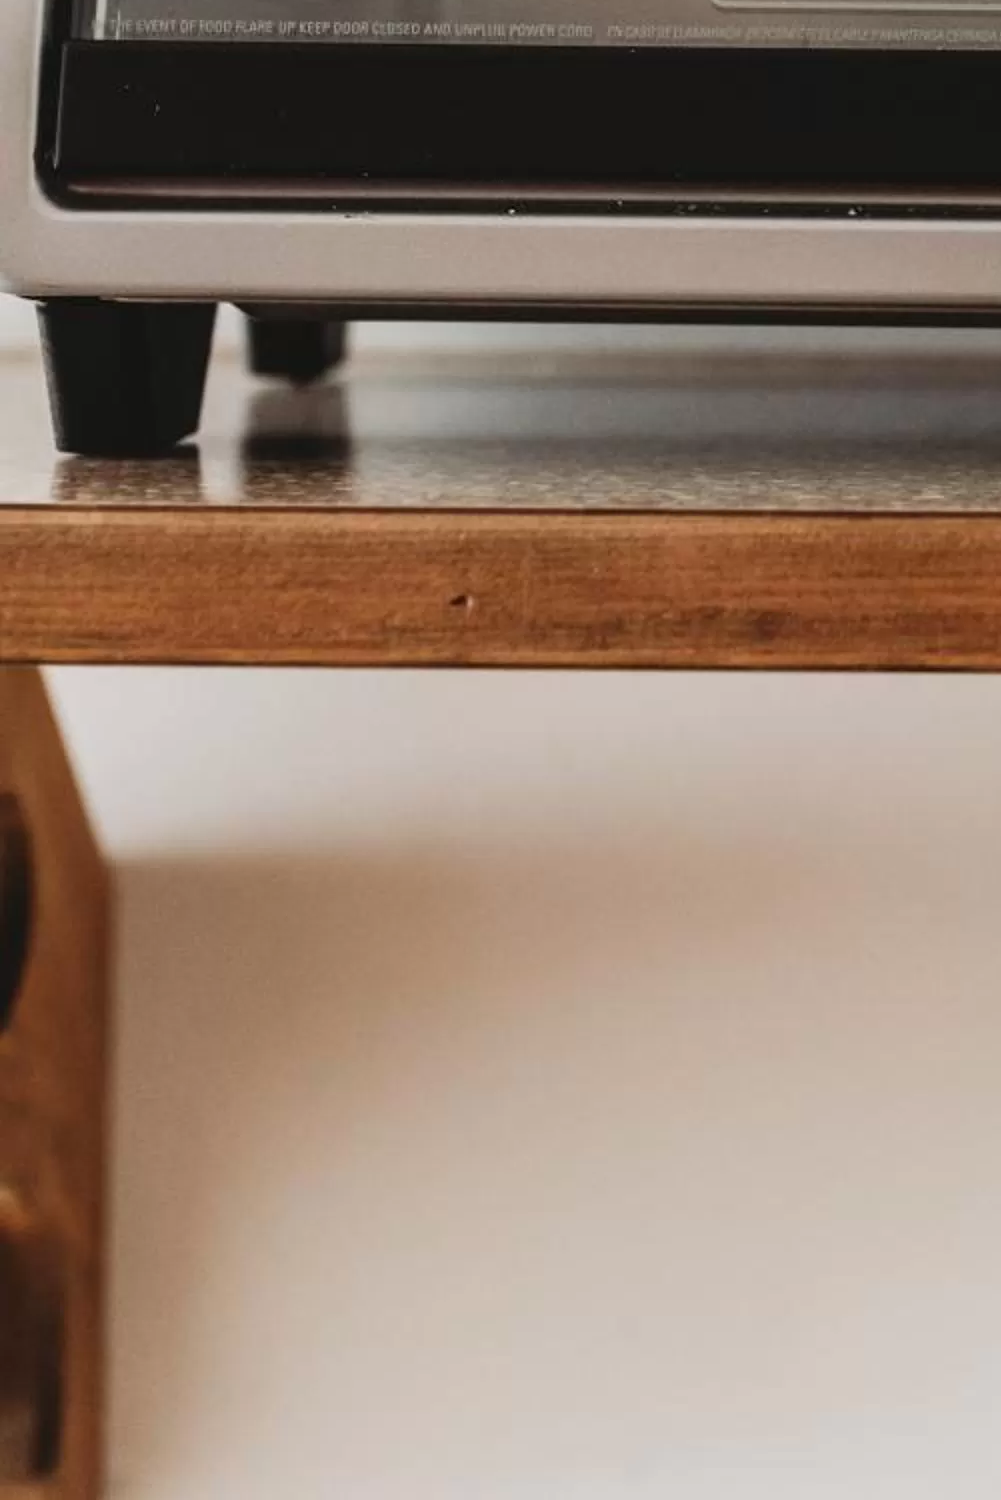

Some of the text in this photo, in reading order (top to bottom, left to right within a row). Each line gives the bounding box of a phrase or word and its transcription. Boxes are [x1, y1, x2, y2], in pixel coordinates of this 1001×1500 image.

[136, 18, 177, 34] EVENT
[180, 18, 197, 33] OF
[199, 18, 232, 34] FOOD
[279, 20, 296, 35] UP
[299, 20, 331, 35] KEEP
[332, 20, 369, 36] DOOR
[371, 21, 421, 36] CLOSED
[423, 22, 452, 37] AND
